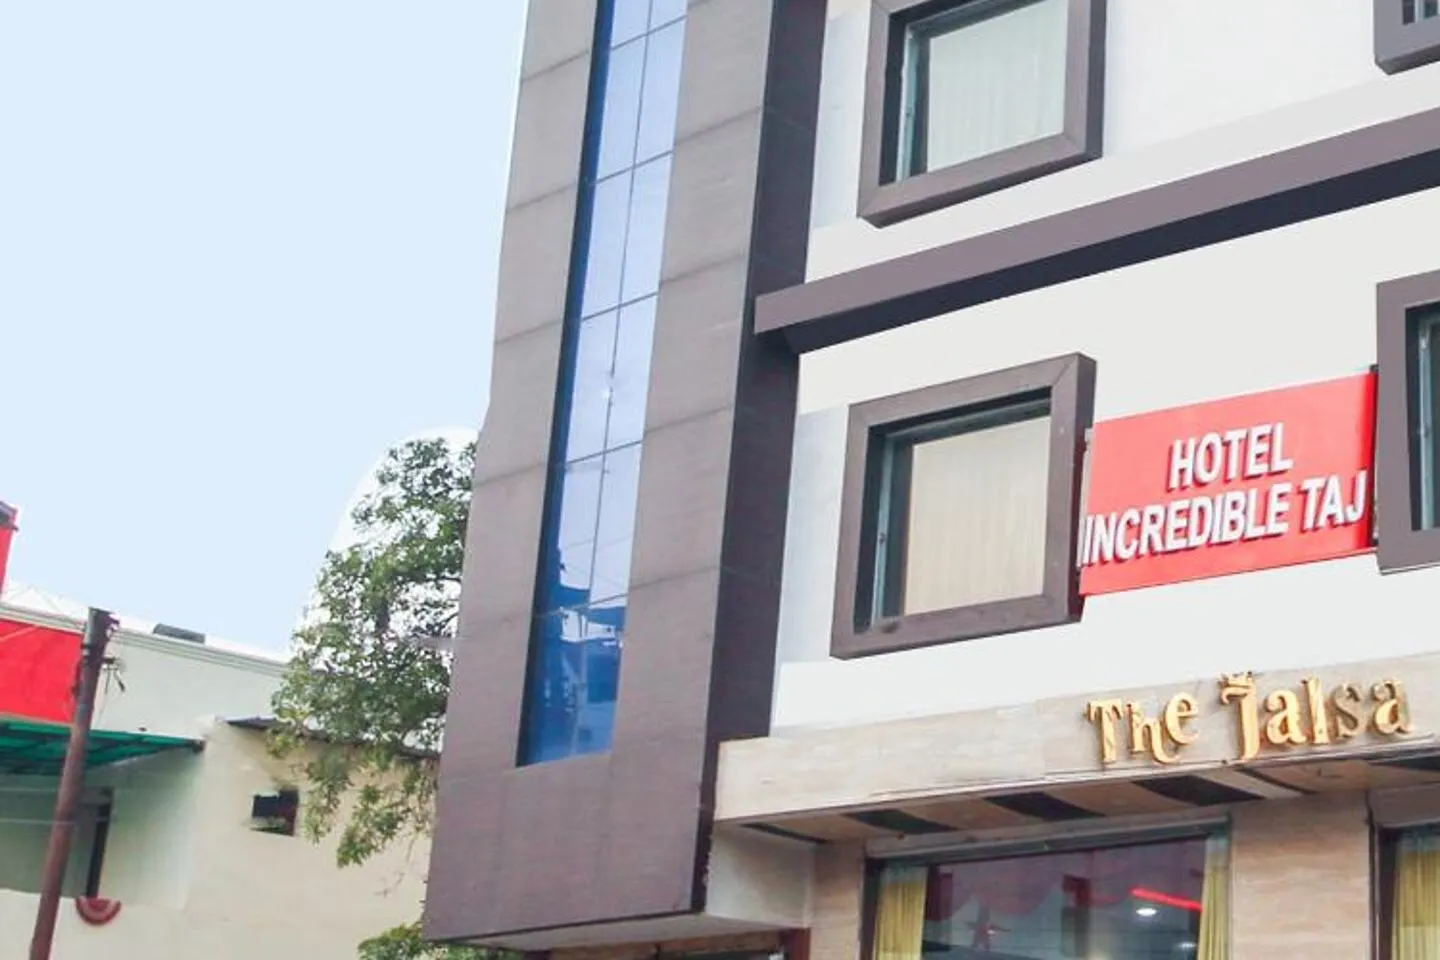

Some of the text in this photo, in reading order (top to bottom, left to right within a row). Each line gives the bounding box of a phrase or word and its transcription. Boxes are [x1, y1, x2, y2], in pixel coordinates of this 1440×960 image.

[1168, 422, 1294, 490] HOTEL
[1079, 470, 1367, 565] INCREDIBLE TAJ
[1085, 671, 1416, 765] The Jalsa
